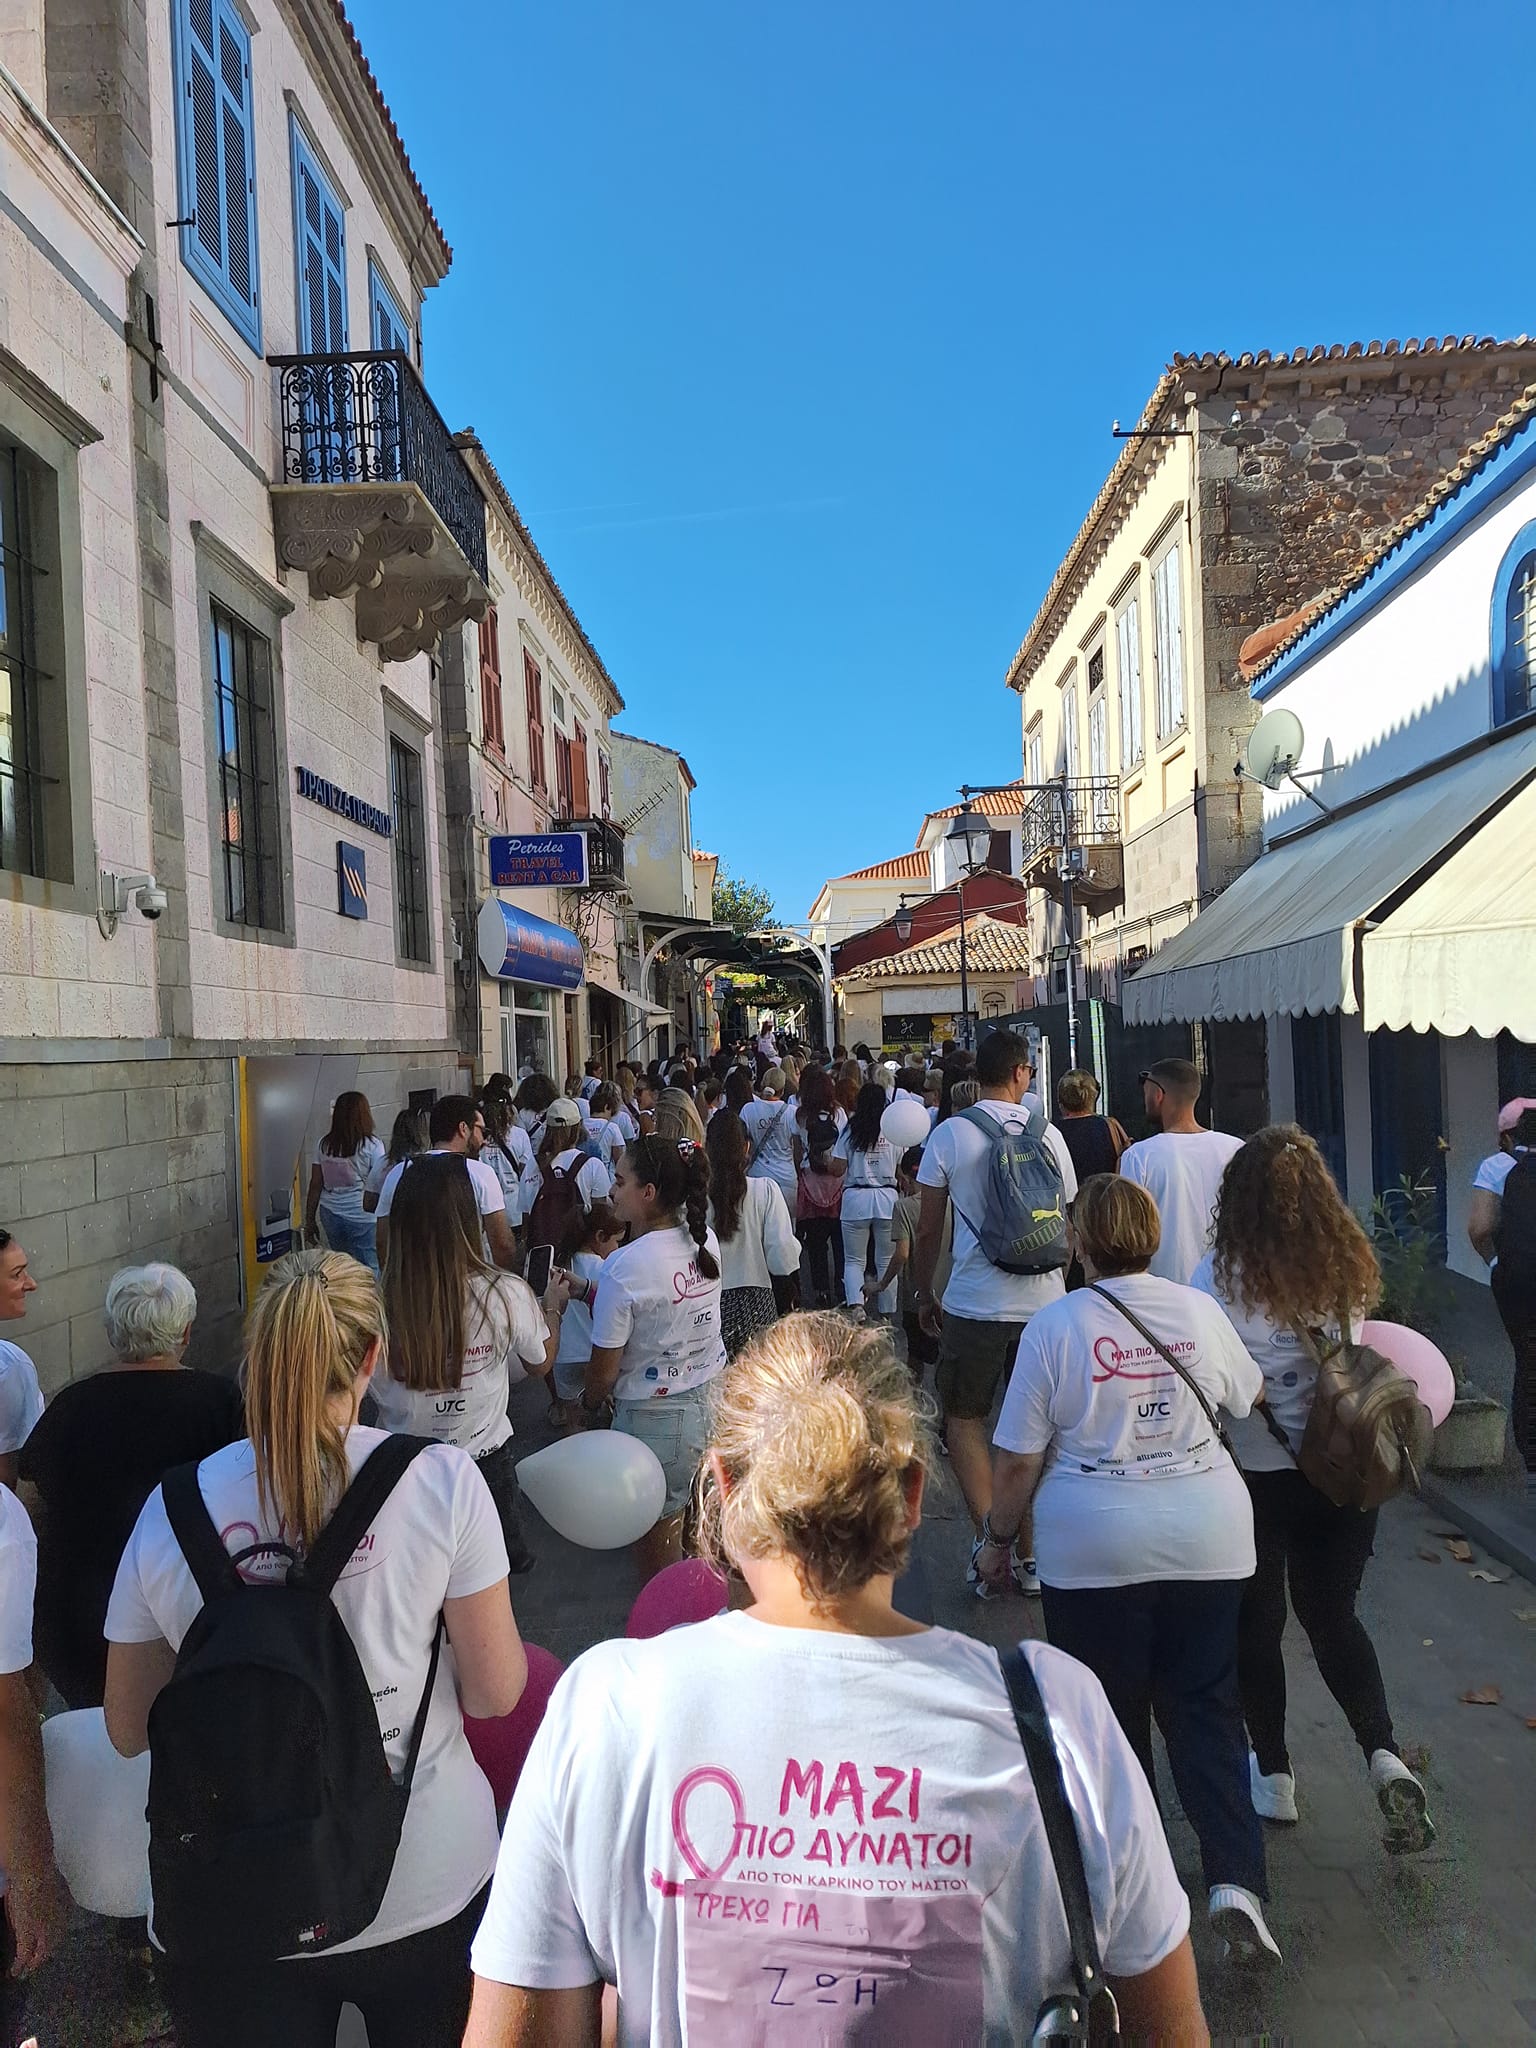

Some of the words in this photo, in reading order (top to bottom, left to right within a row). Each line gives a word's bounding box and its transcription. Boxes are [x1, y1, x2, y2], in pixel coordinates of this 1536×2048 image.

[295, 766, 353, 820] ΤΡΑΠΕΖΑ
[507, 839, 565, 855] Petrides
[510, 856, 564, 869] TRAVEL
[497, 871, 536, 884] RENT
[537, 870, 548, 882] A
[551, 869, 580, 882] CAR
[694, 1311, 712, 1325] UTC
[1275, 1334, 1301, 1345] Roch
[1111, 1348, 1133, 1361] ΜΑΖΙ
[1135, 1347, 1152, 1358] ΠΙΟ
[436, 1400, 465, 1413] UTC
[1138, 1402, 1171, 1418] UTC
[779, 1758, 922, 1826] ΜΑΖΙ
[732, 1822, 796, 1861] ΠΙΟ
[804, 1827, 973, 1868] ΔΥΝΑΤΟΙ
[737, 1870, 769, 1882] ΑΠΟ
[773, 1873, 803, 1885] ΤΟΝ
[807, 1875, 874, 1890] ΚΑΡΚΙΝΟ
[878, 1879, 907, 1892] ΤΟΥ
[911, 1879, 969, 1891] ΜΑΣΤΟΥ
[694, 1892, 770, 1924] ΤΡΕΧΩ
[782, 1901, 820, 1931] ΓΙΑ
[761, 1966, 878, 2007] ΖΩΗ
